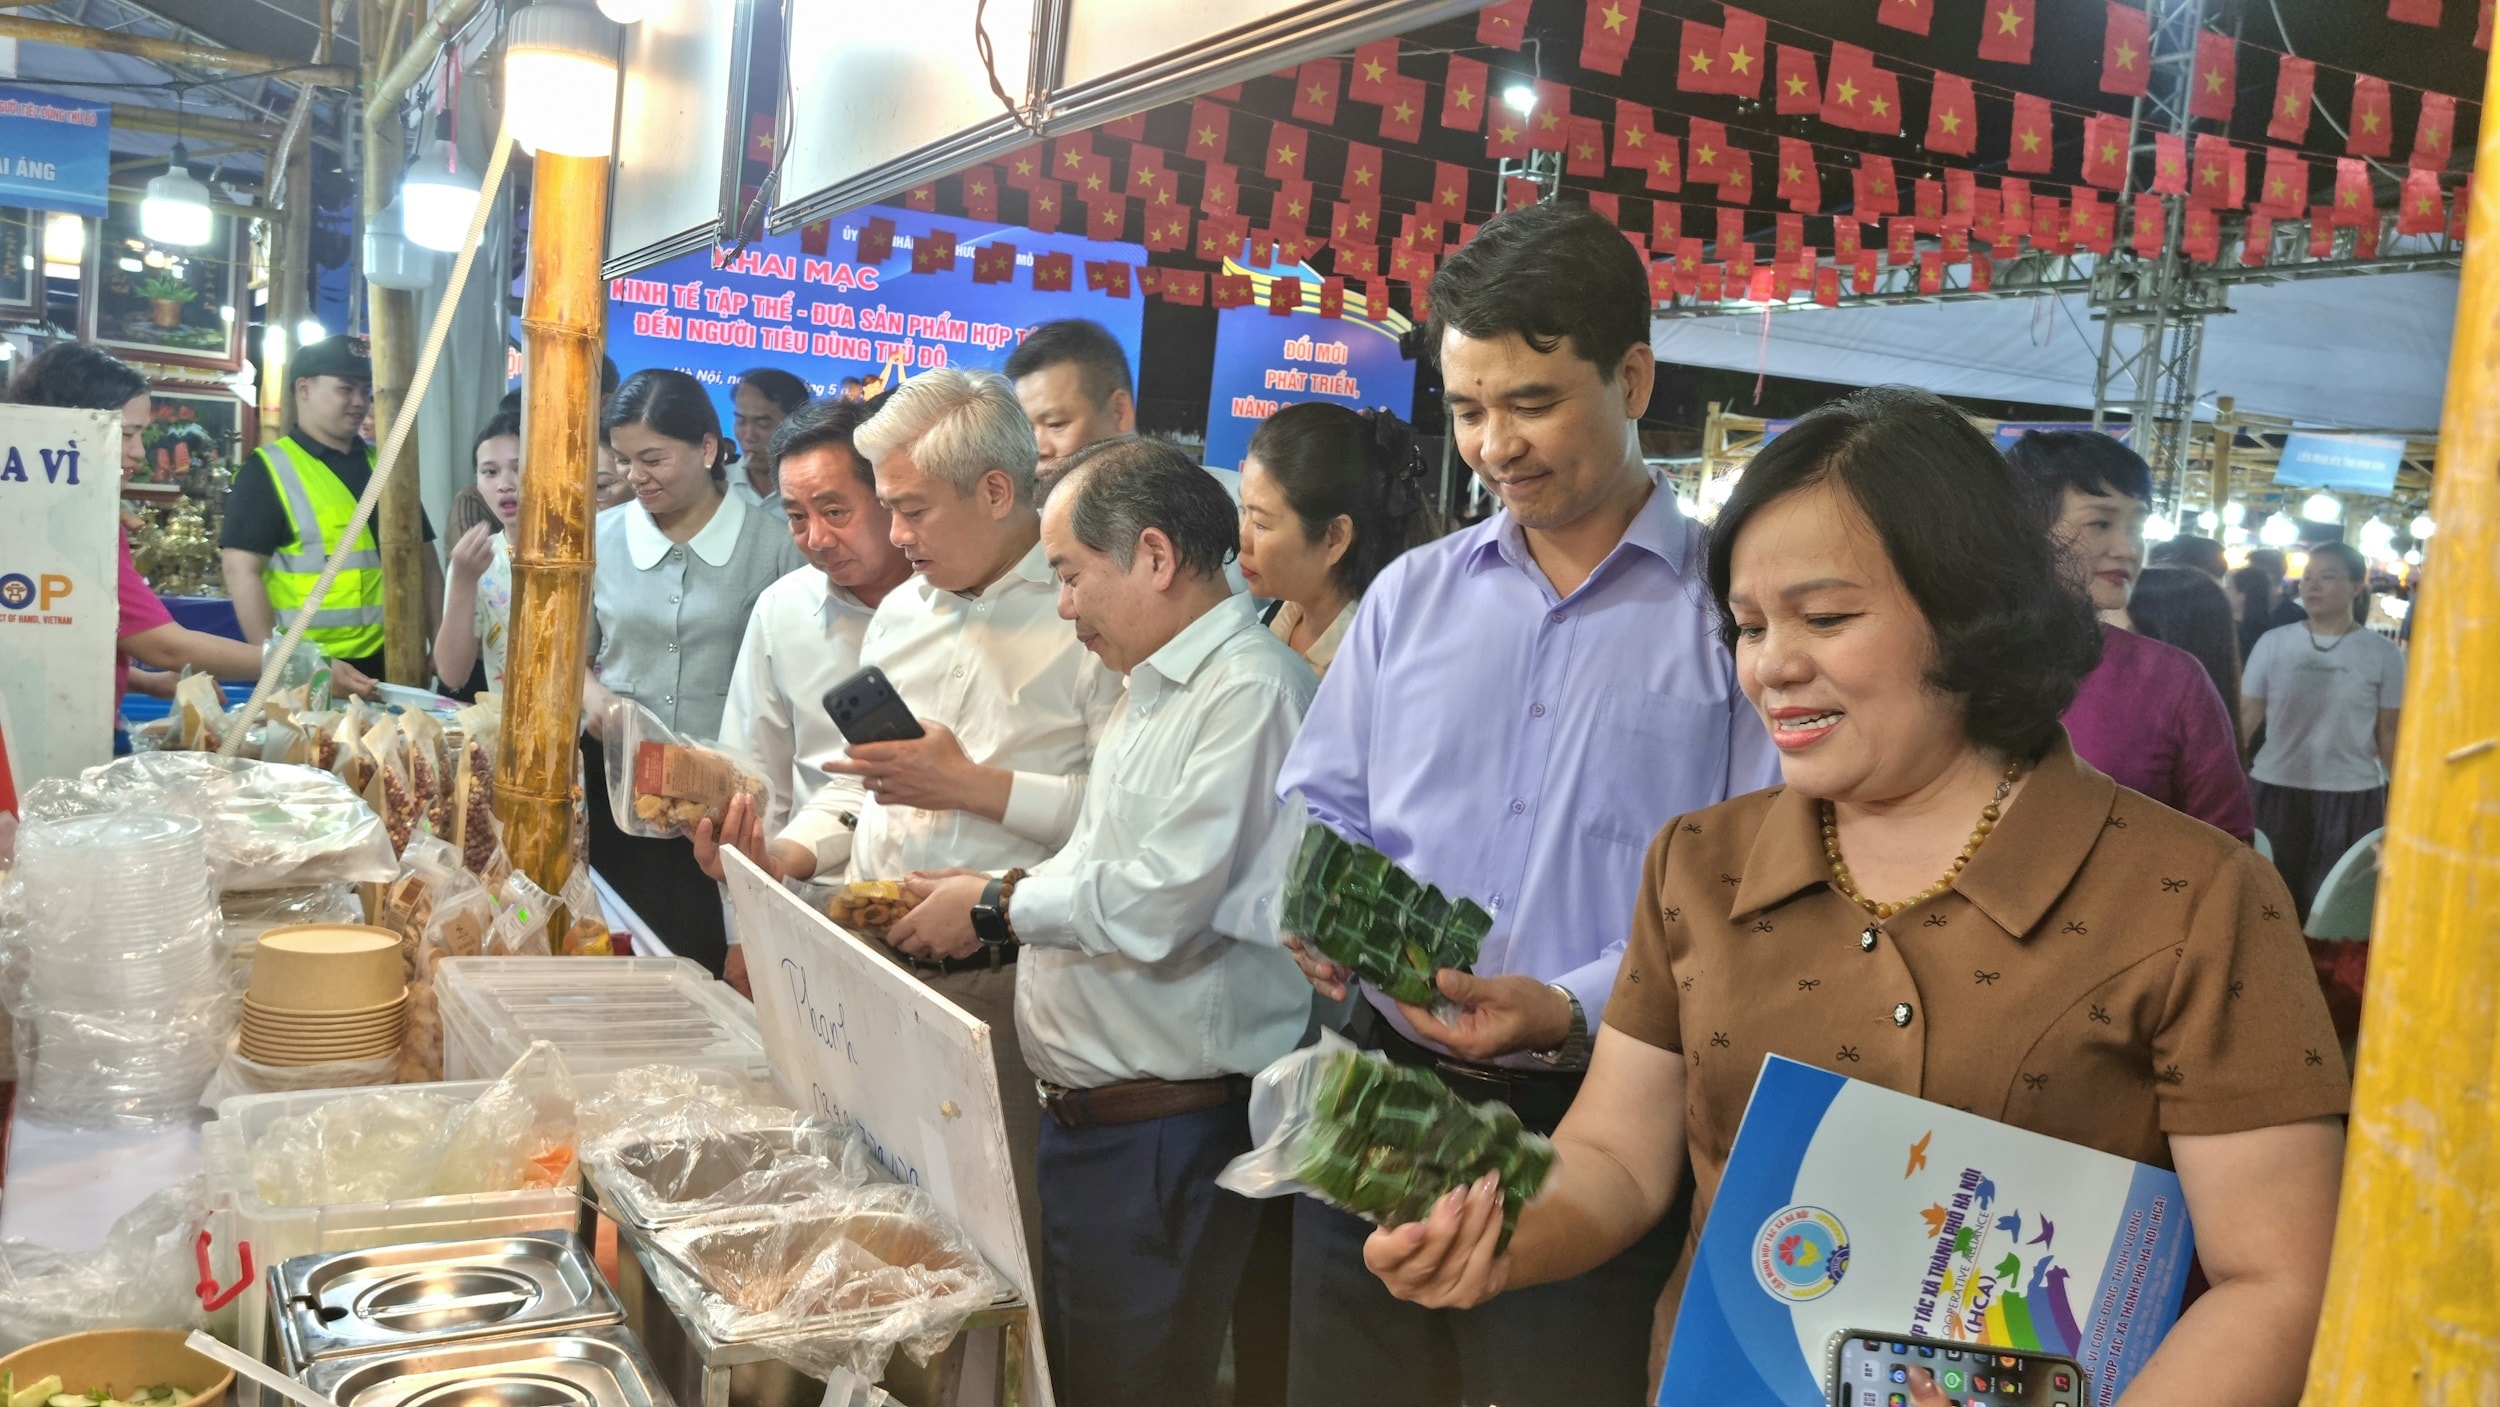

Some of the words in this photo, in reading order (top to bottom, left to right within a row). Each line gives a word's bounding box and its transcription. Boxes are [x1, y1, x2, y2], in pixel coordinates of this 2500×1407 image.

[16, 156, 56, 181] ÁNG
[714, 247, 797, 280] KHAI
[804, 259, 879, 293] MẠC
[610, 278, 668, 306] KINH
[672, 280, 702, 310] TẾ
[706, 287, 748, 318] TẬP
[752, 291, 795, 321] THỂ
[811, 302, 855, 329] ĐƯA
[860, 304, 902, 334] SẢN
[907, 311, 966, 344] PHẨM
[971, 322, 1012, 350] HỢP
[634, 309, 682, 340] ĐẾN
[687, 317, 757, 348] NGƯỜI
[761, 327, 807, 354] TIÊU
[812, 332, 871, 361] DÙNG
[874, 337, 915, 367] THỦ
[918, 347, 948, 369] ĐÔ
[1284, 335, 1313, 360] ĐỔI
[1315, 341, 1348, 365] MỚI
[1265, 368, 1308, 391] PHÁT
[1311, 370, 1360, 398] TRIỂN,
[1232, 395, 1278, 419] NÂNG
[40, 440, 80, 485] VÌ
[1960, 1167, 1984, 1192] NỘI
[1952, 1192, 1973, 1211] HÀ
[1943, 1208, 1966, 1236] PHỐ
[1928, 1236, 1955, 1278] THÀNH
[1921, 1279, 1942, 1298] XÃ
[1941, 1265, 1970, 1338] OOPERATIVE
[1966, 1210, 1990, 1263] ALLIANCE
[2104, 1360, 2119, 1381] HỢP
[2150, 1195, 2167, 1225] (HCA)
[1914, 1297, 1935, 1322] TÁC
[1965, 1275, 1997, 1334] (HCA)
